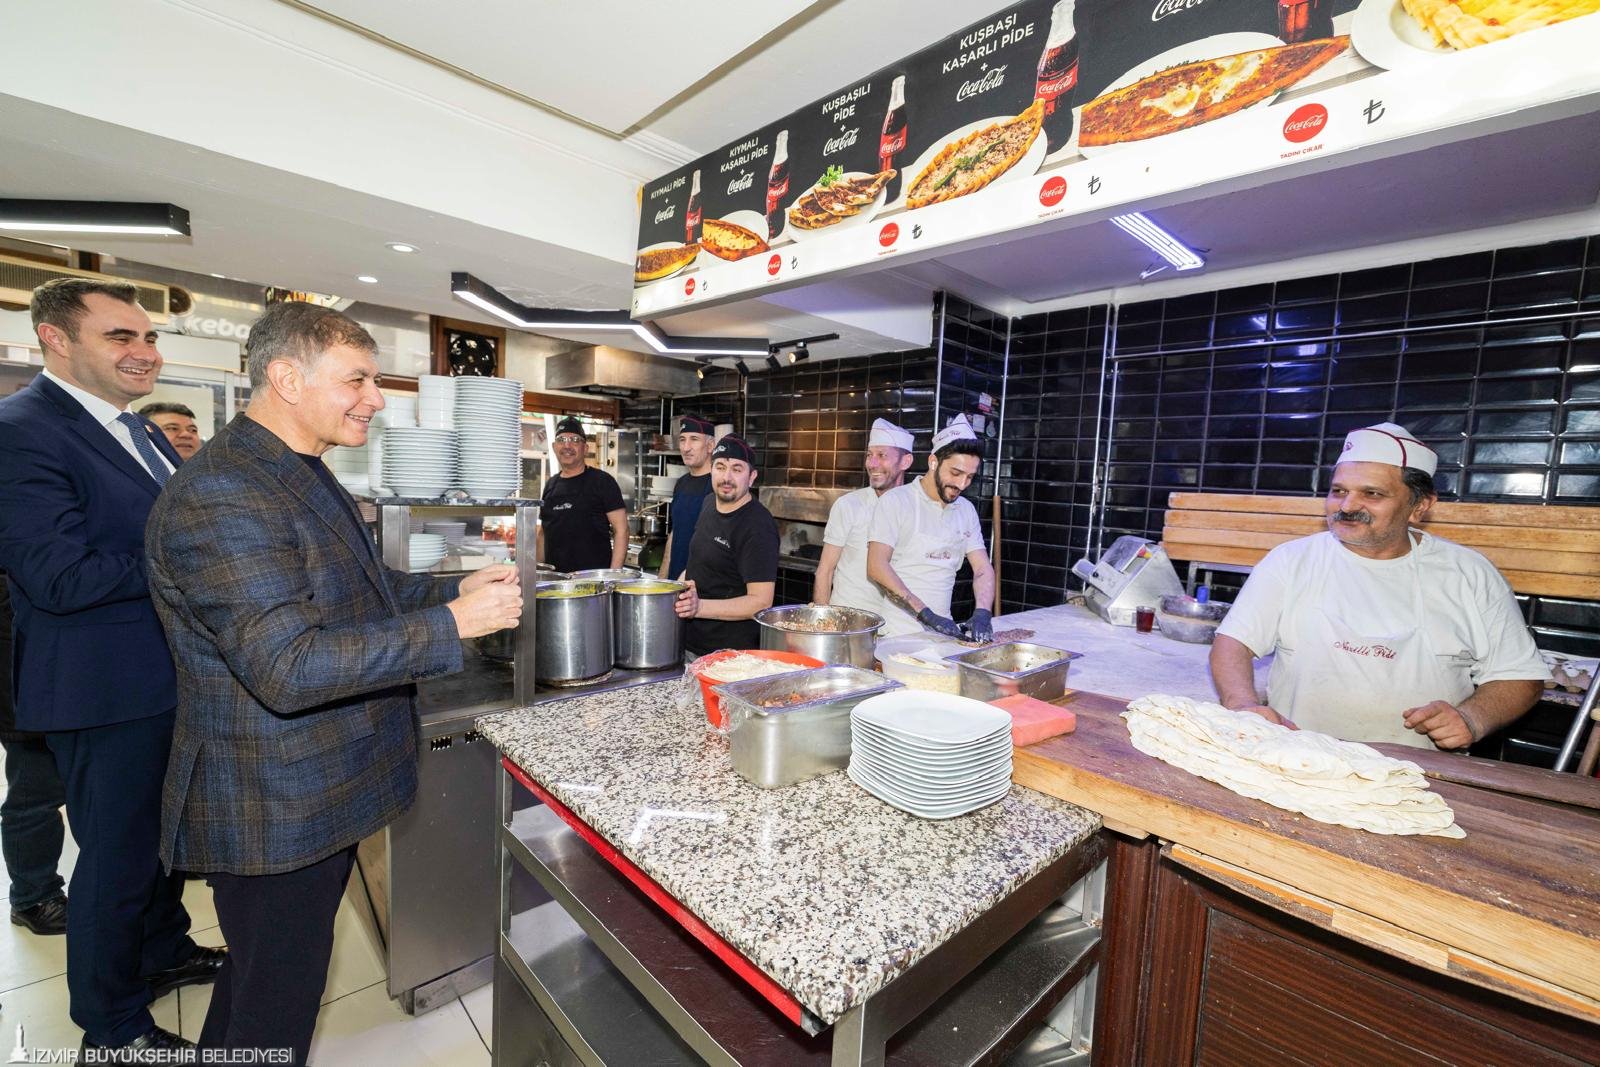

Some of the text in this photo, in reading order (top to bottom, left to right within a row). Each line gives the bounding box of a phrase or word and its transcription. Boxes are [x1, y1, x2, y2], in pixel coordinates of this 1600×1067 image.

[960, 13, 1017, 50] KUŞBAŞI
[942, 22, 1035, 74] KAŞARLI PİDE
[956, 64, 1008, 102] Coca-Cola
[822, 83, 871, 115] KUŞBAŞILI
[833, 104, 856, 123] PİDE
[1285, 114, 1325, 133] Coca-Cola
[729, 137, 759, 158] KIYMALI
[823, 127, 860, 157] Coca-Cola
[720, 144, 769, 173] KAŞARLI PİDE
